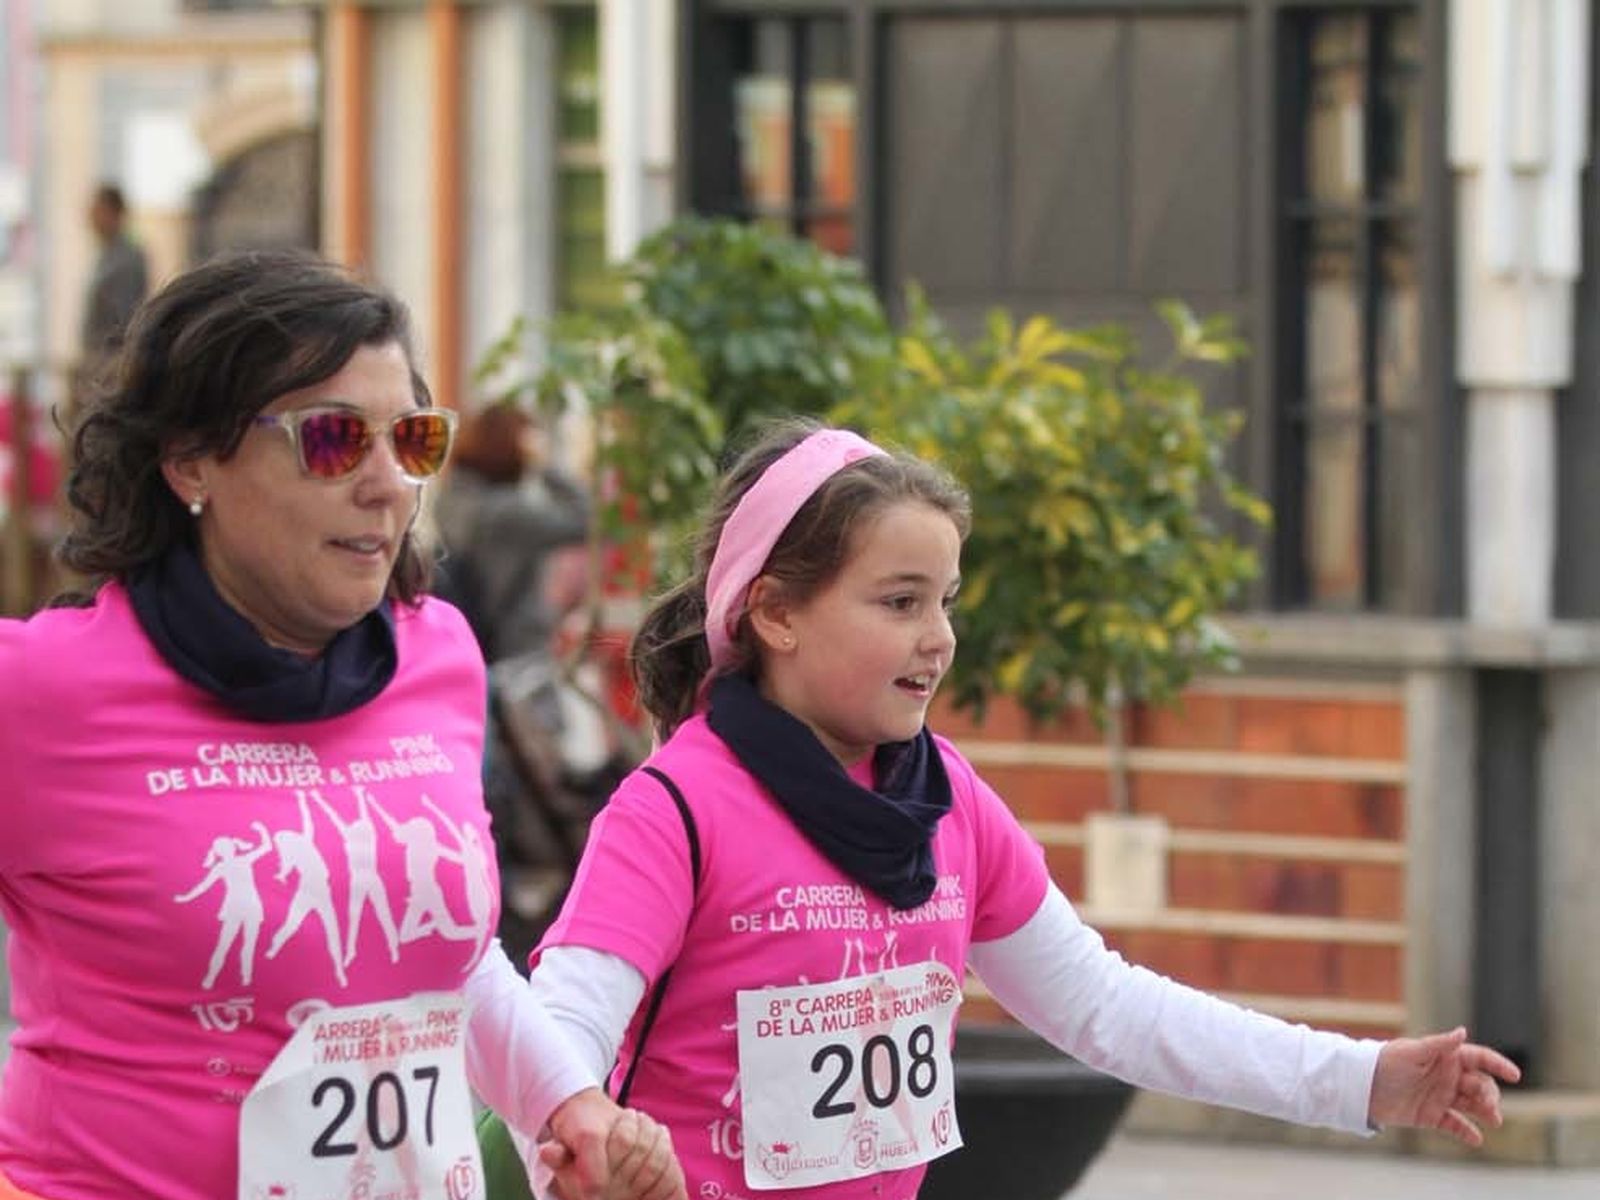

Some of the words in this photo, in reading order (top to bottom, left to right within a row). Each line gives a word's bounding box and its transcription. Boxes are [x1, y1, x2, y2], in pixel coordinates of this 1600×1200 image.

[197, 742, 318, 767] CARRERA
[389, 734, 441, 758] PINK
[146, 767, 187, 795] DE
[194, 765, 231, 787] LA
[238, 763, 325, 787] MUJER
[331, 768, 346, 785] &
[351, 754, 455, 784] RUNNING
[776, 885, 867, 909] CARRERA
[731, 914, 763, 933] DE
[769, 910, 799, 932] LA
[806, 907, 869, 931] MUJER
[872, 914, 884, 929] &
[757, 1019, 783, 1038] DE
[790, 1016, 815, 1035] LA
[821, 1005, 874, 1033] MUJER
[879, 1009, 889, 1022] &
[893, 988, 954, 1019] RUNNING
[796, 987, 873, 1016] CARRERA
[314, 1015, 381, 1041] ARRERA
[323, 1038, 381, 1063] MUJER
[810, 1023, 938, 1119] 208
[310, 1065, 441, 1159] 207
